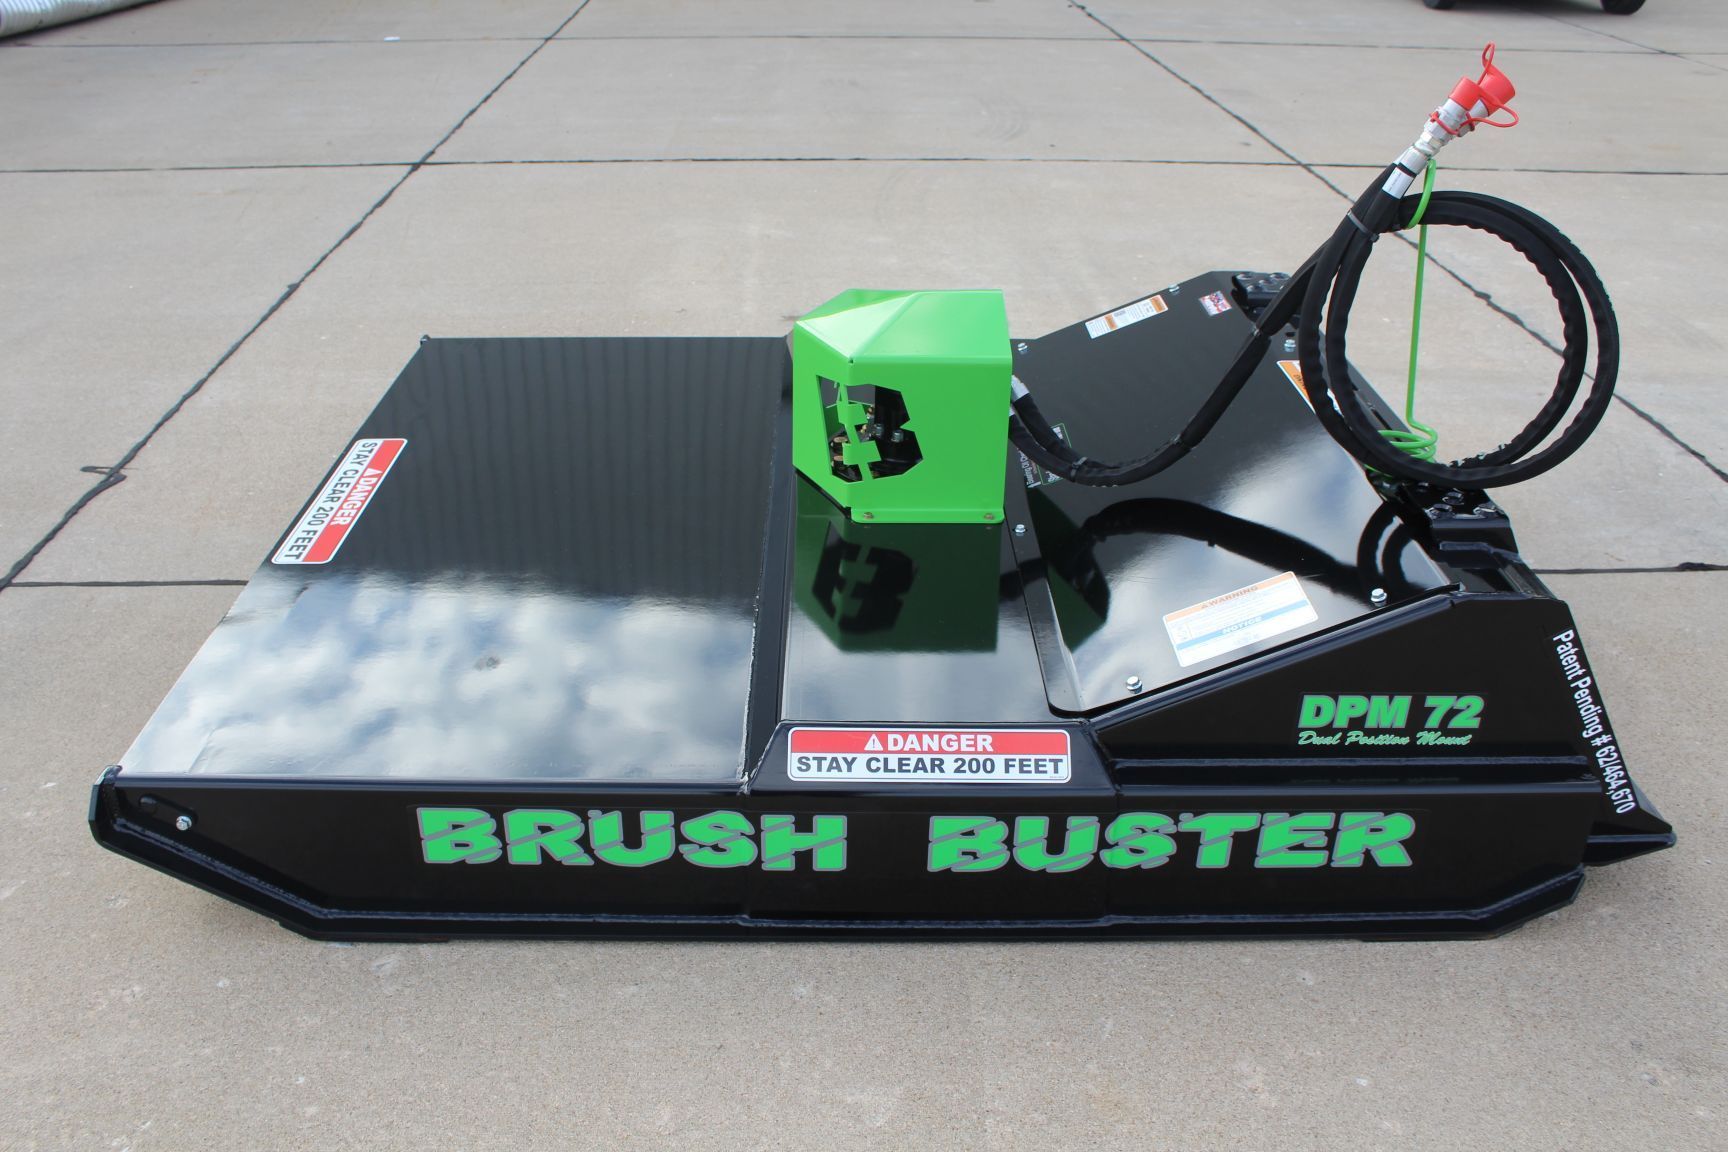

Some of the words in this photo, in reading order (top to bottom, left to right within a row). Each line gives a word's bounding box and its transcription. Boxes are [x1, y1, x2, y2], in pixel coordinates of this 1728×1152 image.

[351, 442, 378, 466] STAY
[323, 468, 359, 504] CLEAR
[330, 477, 379, 526] DANGER
[307, 506, 334, 527] 200
[284, 529, 318, 560] FEET
[1211, 585, 1259, 607] WARNING
[1222, 616, 1263, 634] NOTICE
[1552, 629, 1586, 681] Patent
[1298, 694, 1413, 728] DPM
[1424, 695, 1485, 728] 72
[1570, 676, 1604, 738] Pending
[887, 733, 994, 752] DANGER
[1298, 730, 1342, 745] Dual
[1345, 730, 1410, 745] Position
[1416, 731, 1472, 746] Mount
[1590, 734, 1613, 747] #
[796, 756, 857, 773] STAY
[865, 756, 945, 774] CLEAR
[953, 757, 996, 774] 200
[1004, 758, 1063, 775] FEET
[1595, 745, 1636, 814] 62/464,670
[417, 807, 848, 872] BRUSH
[927, 811, 1416, 873] BUSTER
